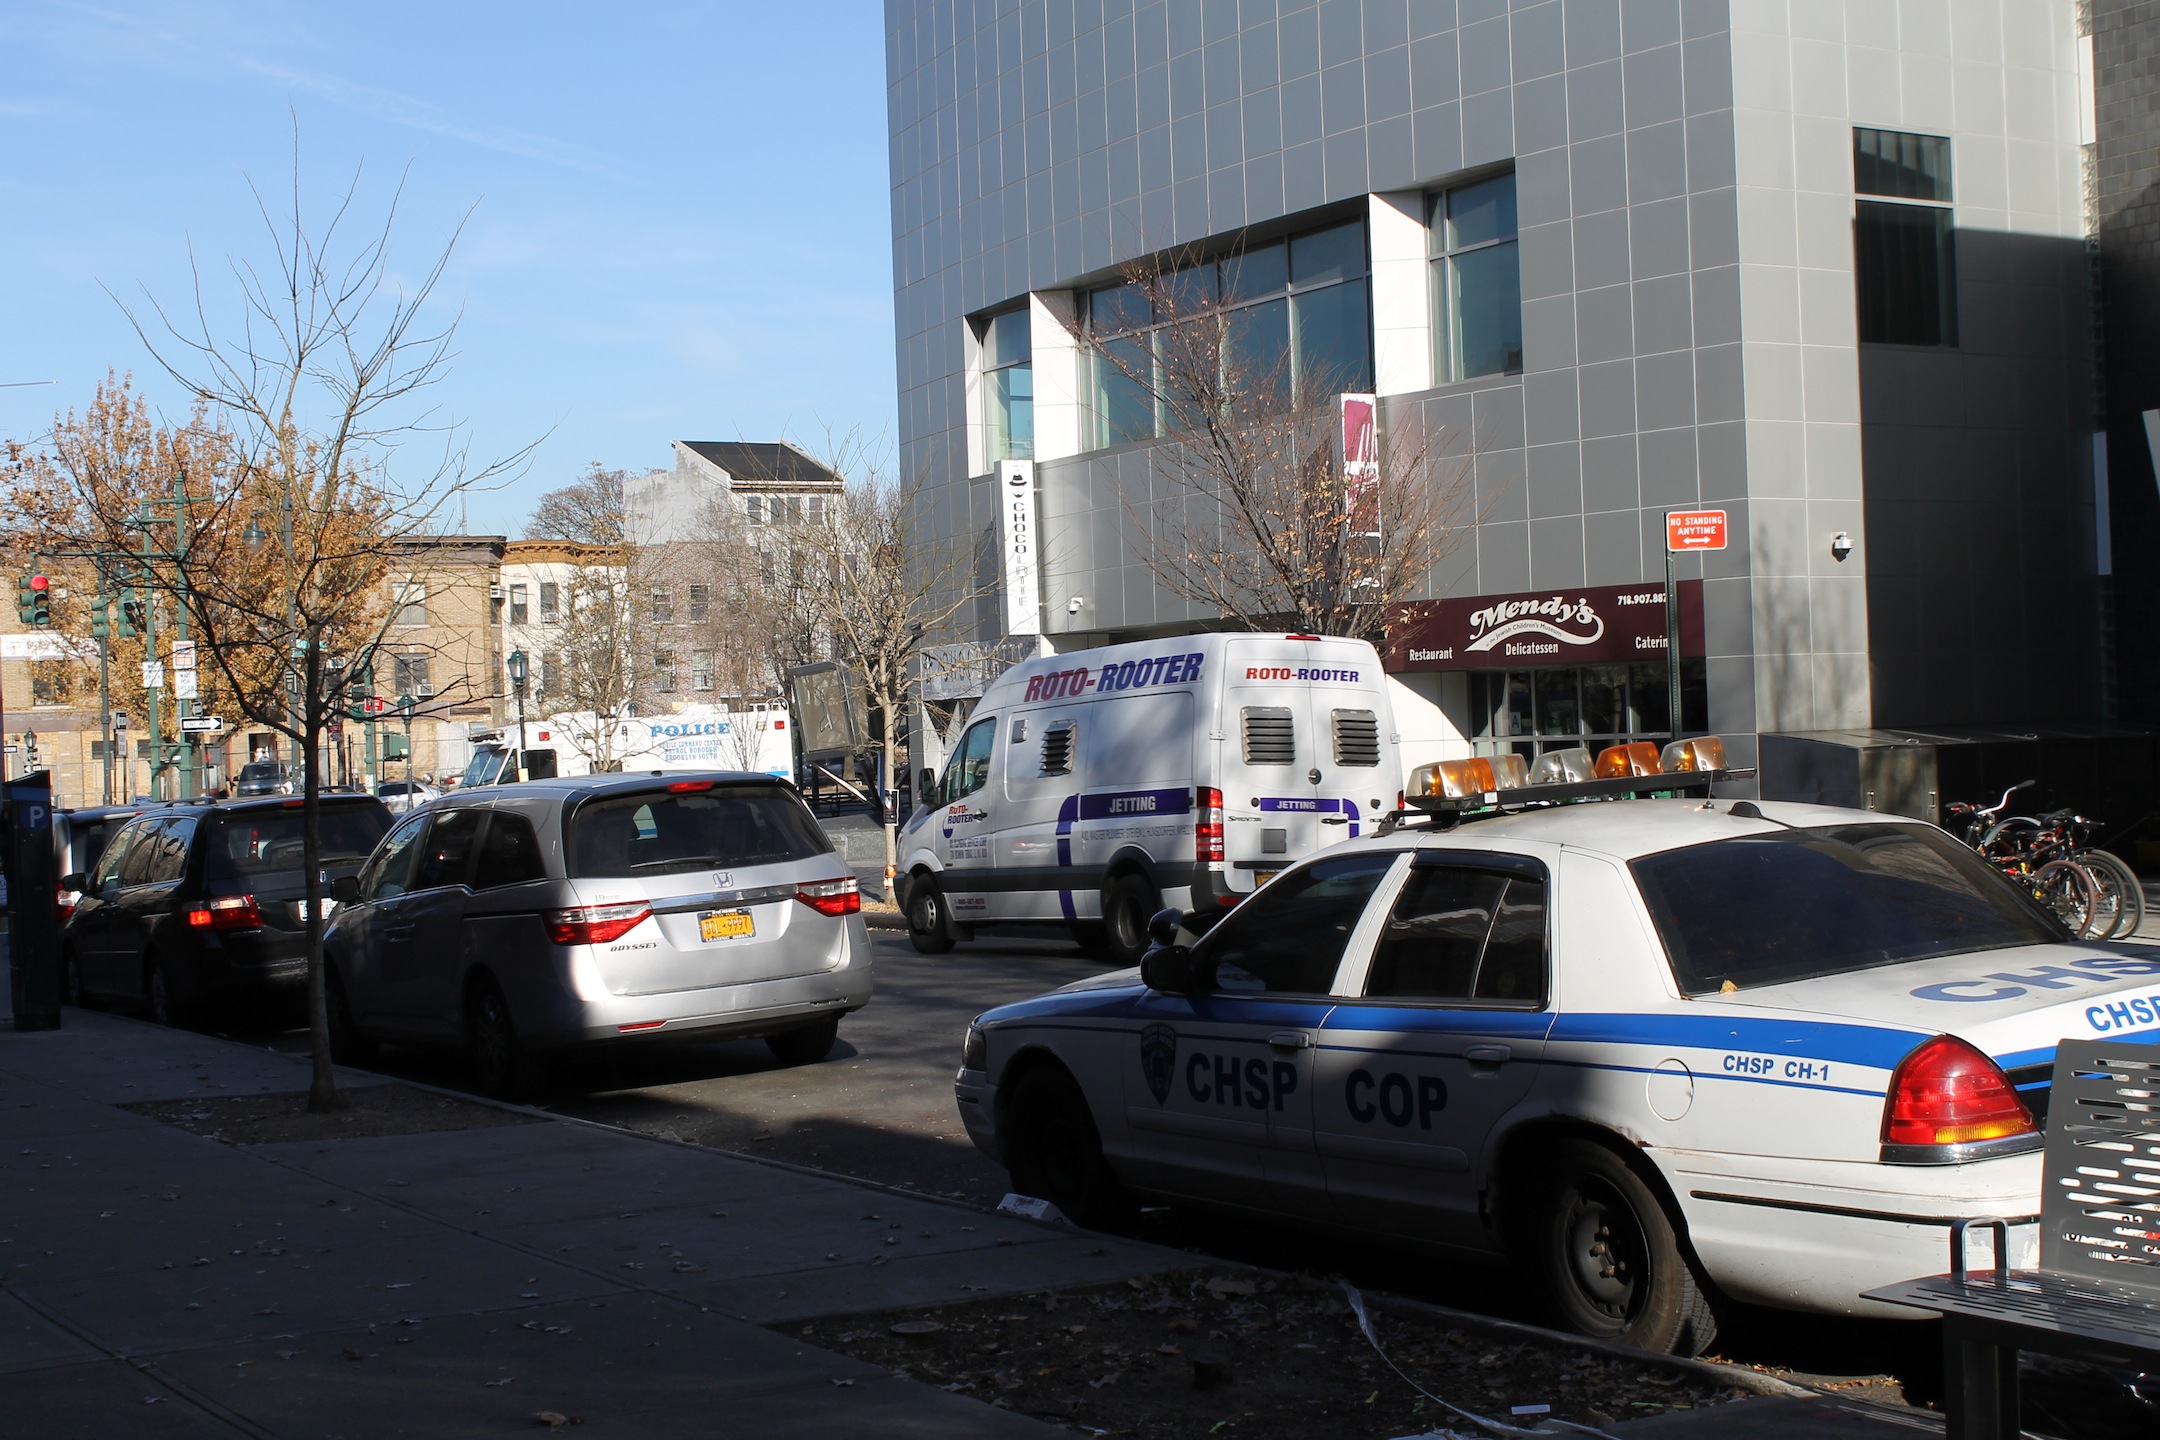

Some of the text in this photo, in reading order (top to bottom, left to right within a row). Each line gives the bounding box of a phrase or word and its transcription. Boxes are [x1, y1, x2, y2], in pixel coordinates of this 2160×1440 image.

[1670, 516, 1723, 526] NO STANDING
[1677, 526, 1717, 536] ANYTIME
[1470, 596, 1595, 640] Mendy's
[1495, 627, 1512, 641] Jewish
[1512, 622, 1539, 631] Children's
[1540, 623, 1562, 637] Museum
[1409, 635, 1668, 661] Restaurant Delicatessen Caterin
[1511, 714, 1520, 729] A
[650, 722, 731, 738] POLICE
[1109, 796, 1156, 813] JETTING
[1276, 800, 1316, 810] JETTING
[30, 805, 45, 828] P
[947, 813, 974, 824] ROOTER
[610, 942, 658, 952] ODYSSEY
[1722, 1054, 1829, 1081] CHSP CH-1
[1186, 1052, 1448, 1131] CHSP COP
